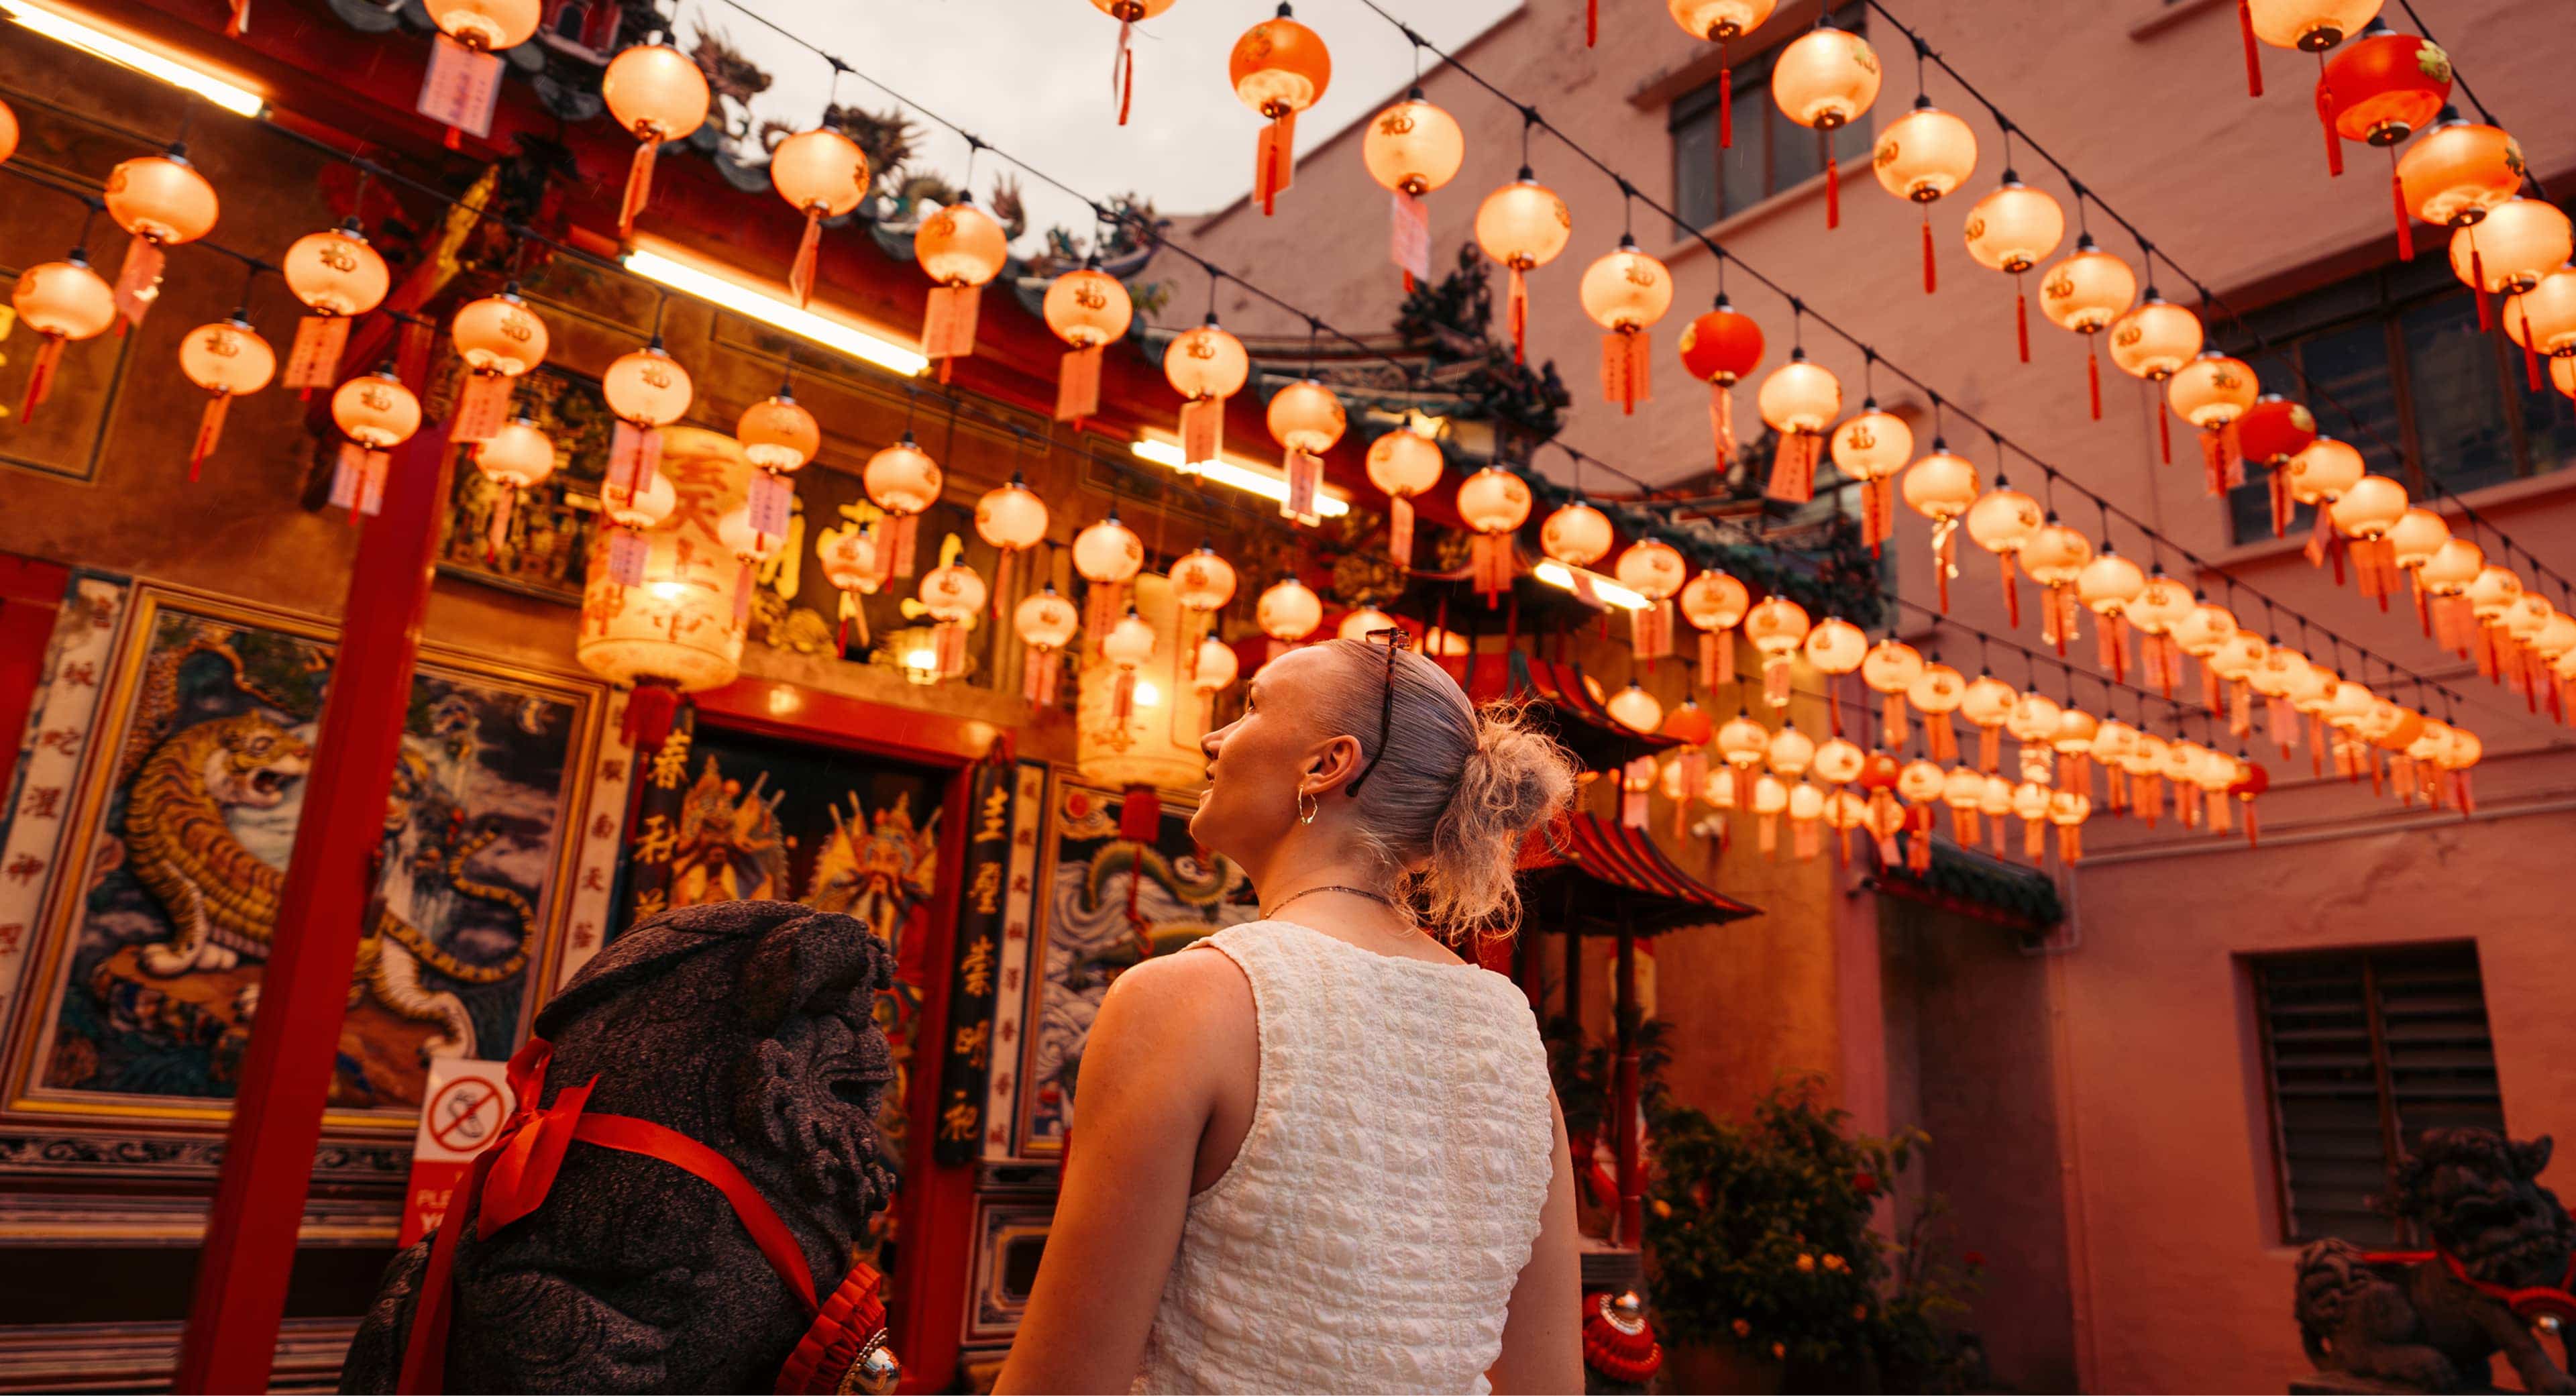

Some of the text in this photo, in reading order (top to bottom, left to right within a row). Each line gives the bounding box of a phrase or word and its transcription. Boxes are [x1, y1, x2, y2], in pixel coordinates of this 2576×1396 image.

[1380, 108, 1413, 136] 福
[319, 242, 358, 273] 福
[1625, 258, 1656, 287] 福
[2046, 271, 2076, 298] 福
[1075, 279, 1107, 309] 福
[500, 310, 532, 341] 福
[2117, 326, 2141, 347] 福
[205, 331, 239, 357] 福
[1186, 335, 1215, 359] 福
[641, 361, 672, 389] 福
[2212, 366, 2243, 389] 福
[360, 387, 392, 412] 福
[1848, 425, 1875, 448] 福
[415, 1189, 453, 1209] PLE
